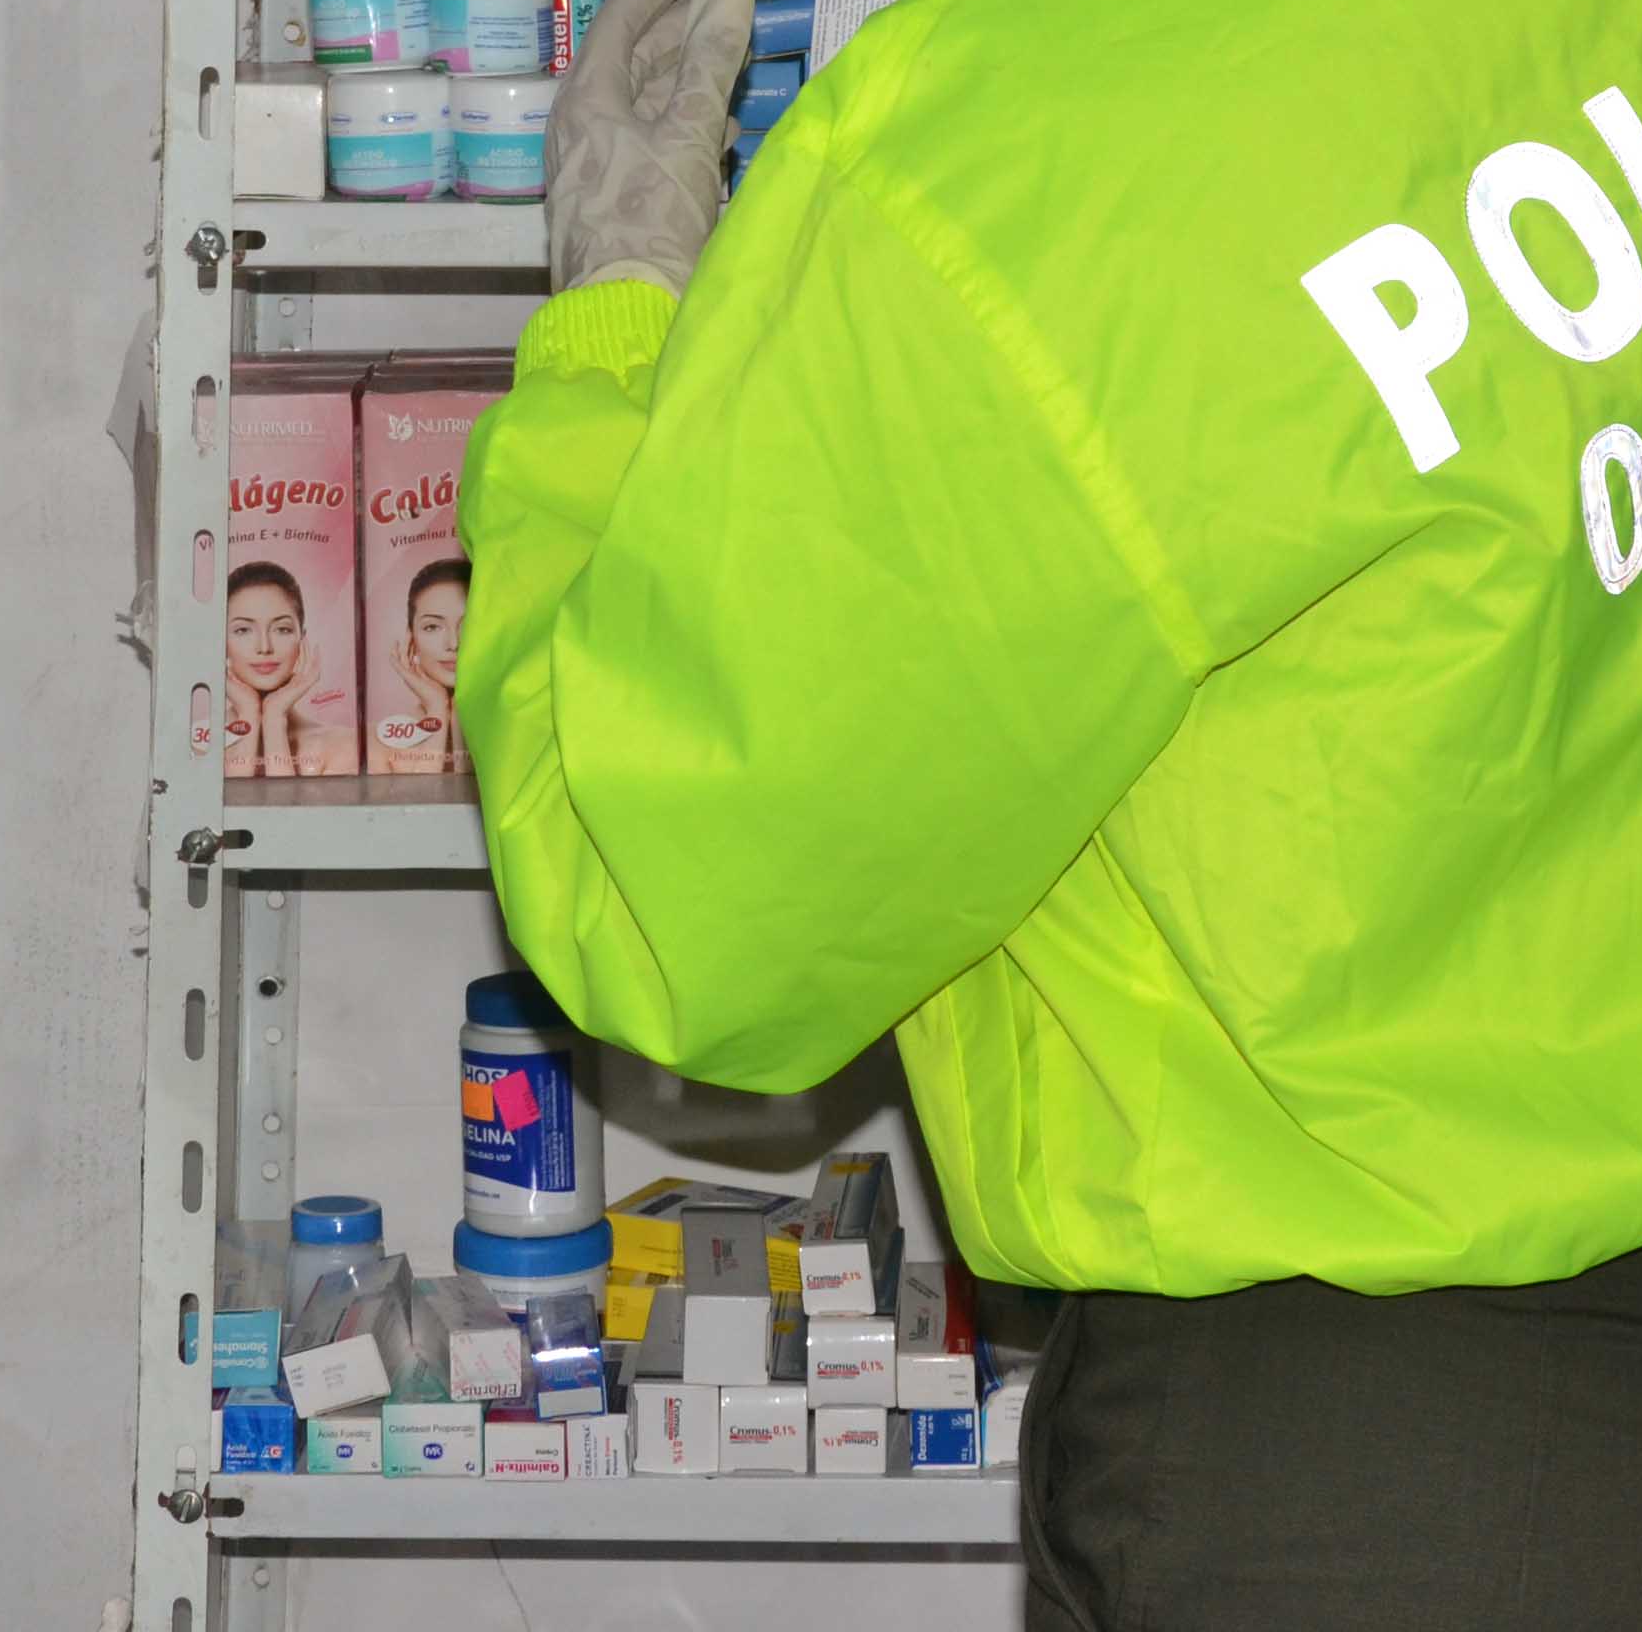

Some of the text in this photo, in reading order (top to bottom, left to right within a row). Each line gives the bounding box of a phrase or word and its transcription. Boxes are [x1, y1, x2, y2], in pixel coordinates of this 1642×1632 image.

[229, 474, 345, 514] lágeno
[285, 528, 331, 544] Biotina
[390, 527, 447, 548] Vitamina
[383, 722, 415, 739] 360
[817, 1361, 884, 1372] Cromus 0,1%
[673, 1397, 683, 1439] Cromus
[730, 1425, 796, 1436] Cromus 0,1%
